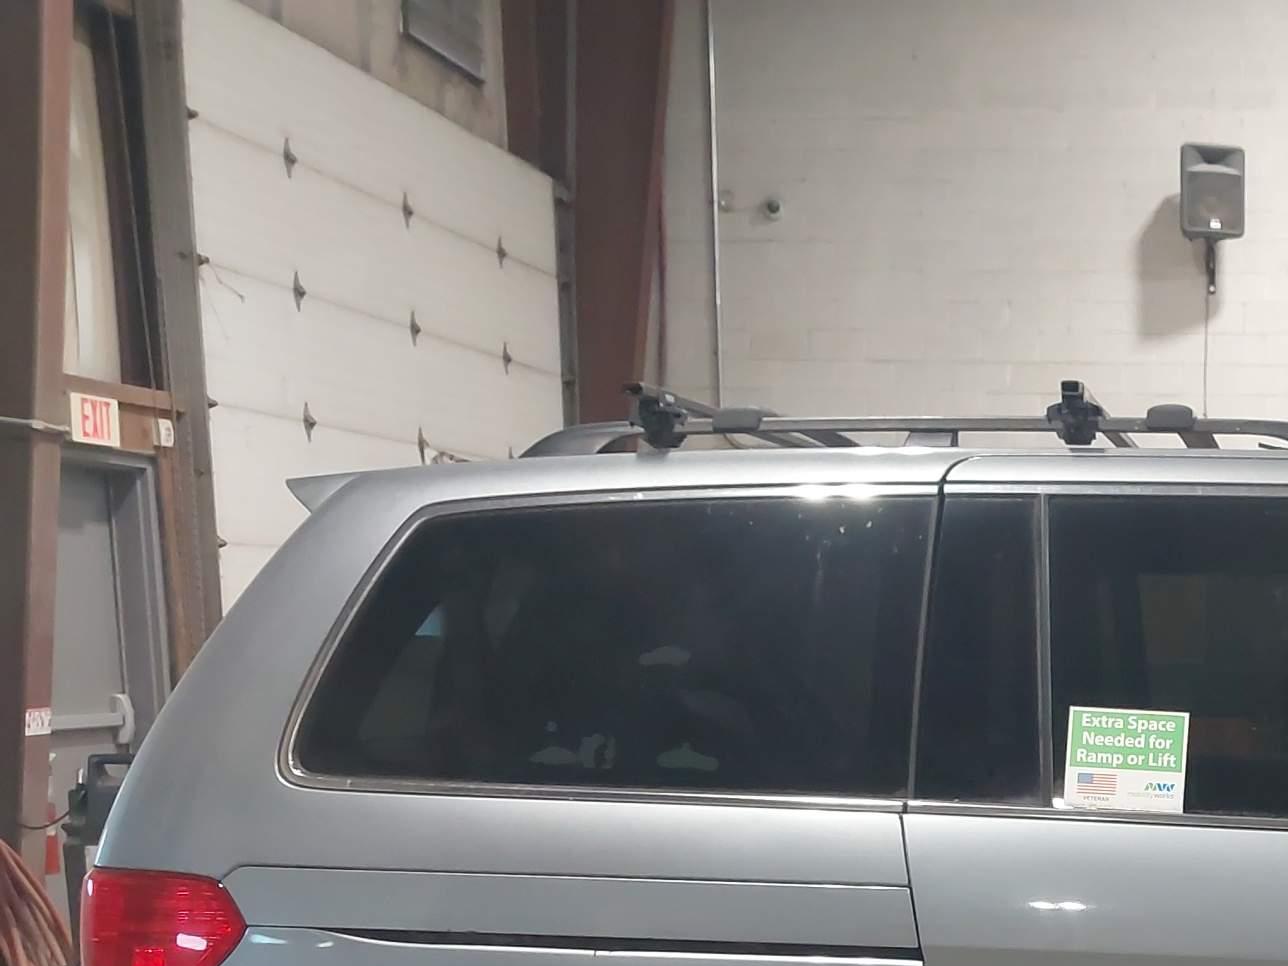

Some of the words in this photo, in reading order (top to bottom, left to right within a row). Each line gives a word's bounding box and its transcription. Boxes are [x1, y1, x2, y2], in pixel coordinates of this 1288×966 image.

[81, 398, 111, 440] EXIT
[1081, 713, 1124, 729] Extra
[1128, 716, 1176, 733] Space
[1082, 731, 1145, 748] Needed
[1149, 734, 1173, 749] for
[1076, 748, 1123, 767] Ramp
[1127, 754, 1145, 766] or
[1148, 752, 1177, 768] Lift
